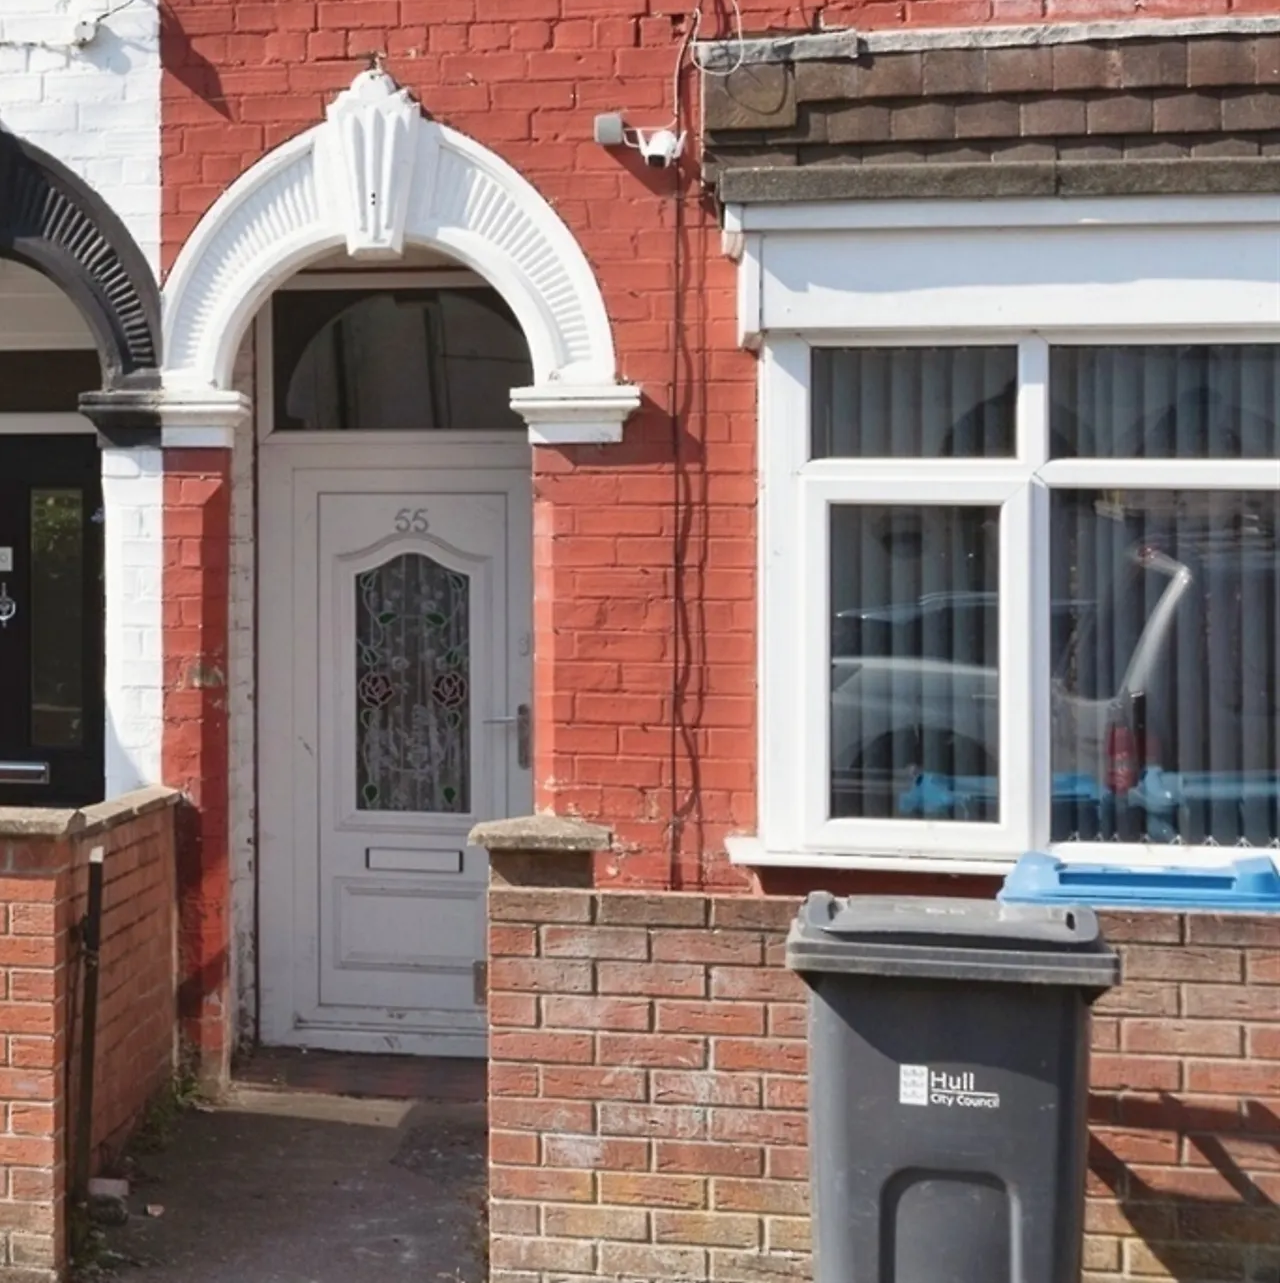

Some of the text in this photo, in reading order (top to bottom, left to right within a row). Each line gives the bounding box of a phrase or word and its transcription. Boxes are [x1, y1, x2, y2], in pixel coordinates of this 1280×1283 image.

[394, 508, 429, 533] 55
[930, 1070, 975, 1091] Hull
[929, 1093, 1000, 1108] City Council
